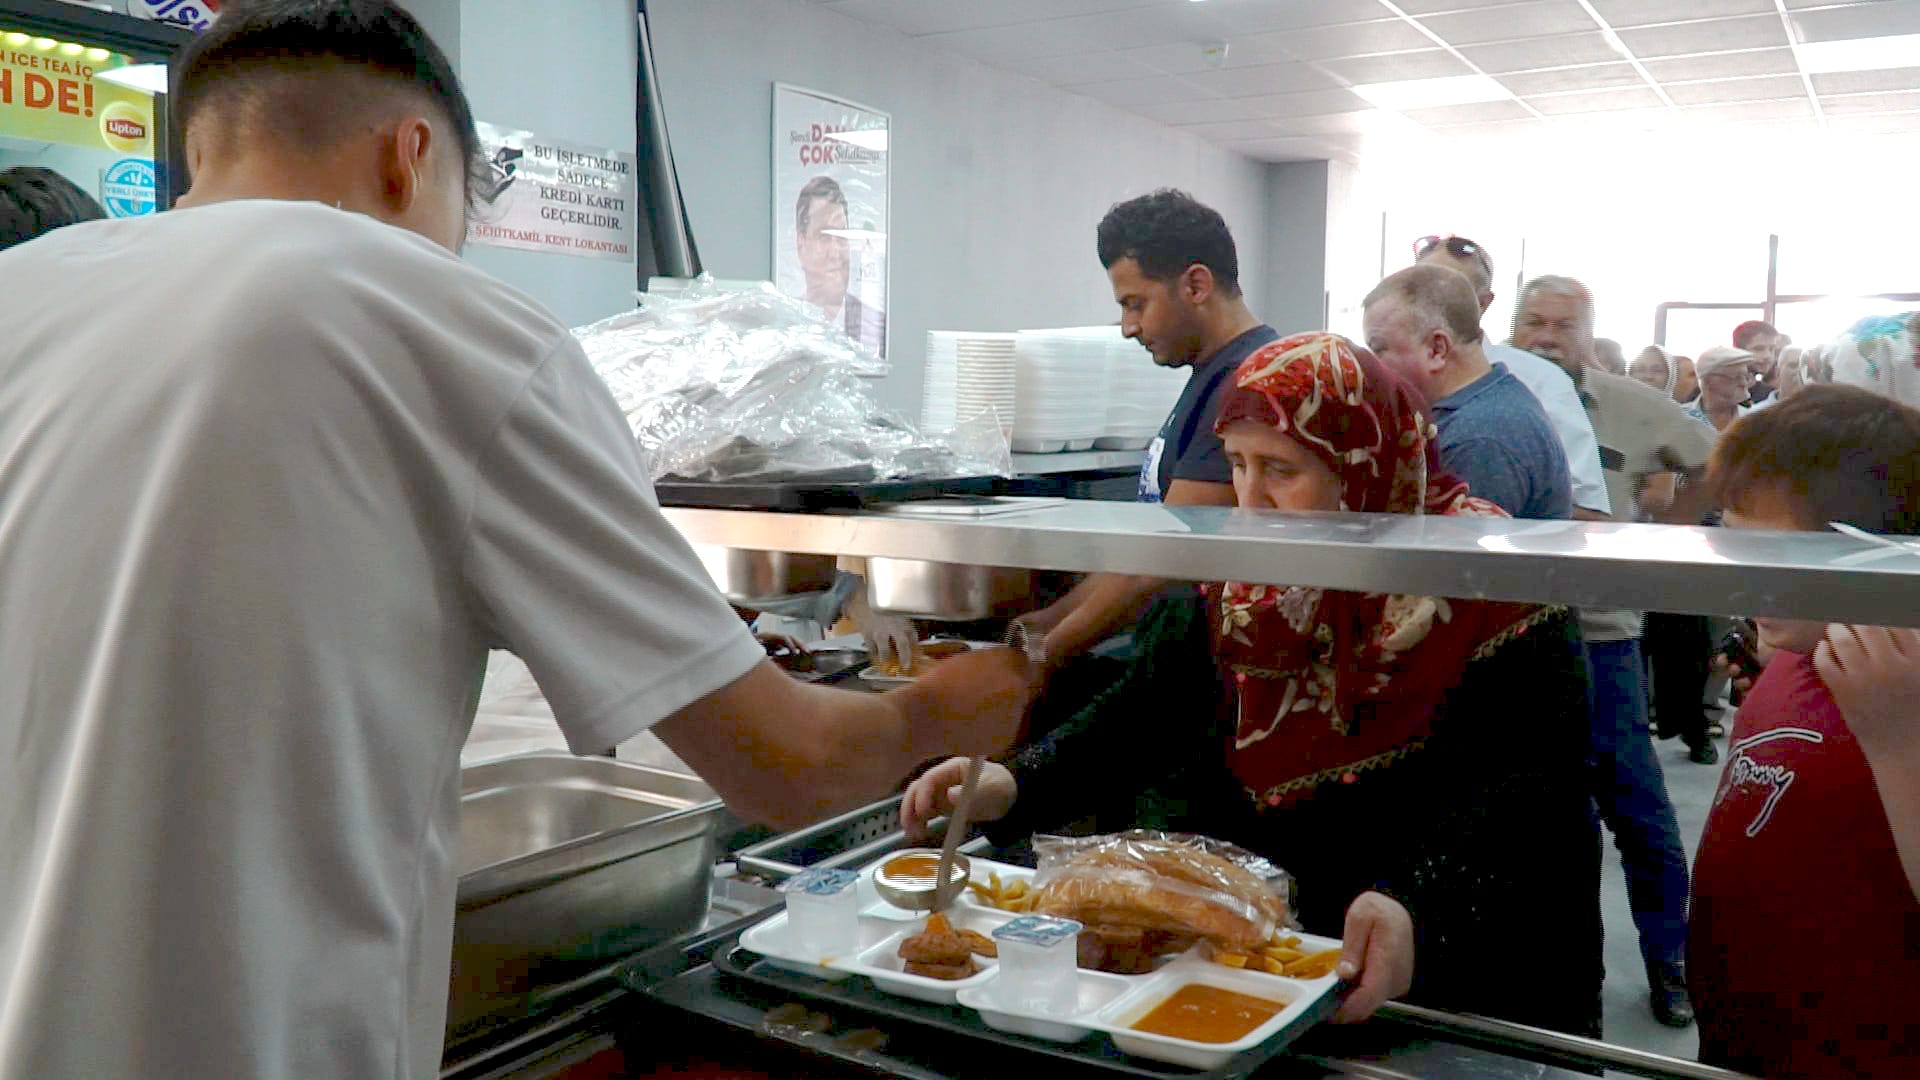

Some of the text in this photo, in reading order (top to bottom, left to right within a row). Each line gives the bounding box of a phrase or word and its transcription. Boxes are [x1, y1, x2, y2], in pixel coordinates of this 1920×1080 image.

[10, 52, 38, 68] ICE
[42, 57, 71, 74] TEA
[24, 73, 94, 118] DE!
[109, 121, 143, 137] Lipton
[534, 144, 630, 175] BU İŞLETMEDE
[799, 144, 834, 167] ÇOK
[557, 169, 609, 191] SADECE
[540, 185, 625, 212] KREDİ KARTI
[545, 233, 572, 248] KENT
[575, 237, 629, 255] LOKANTASI
